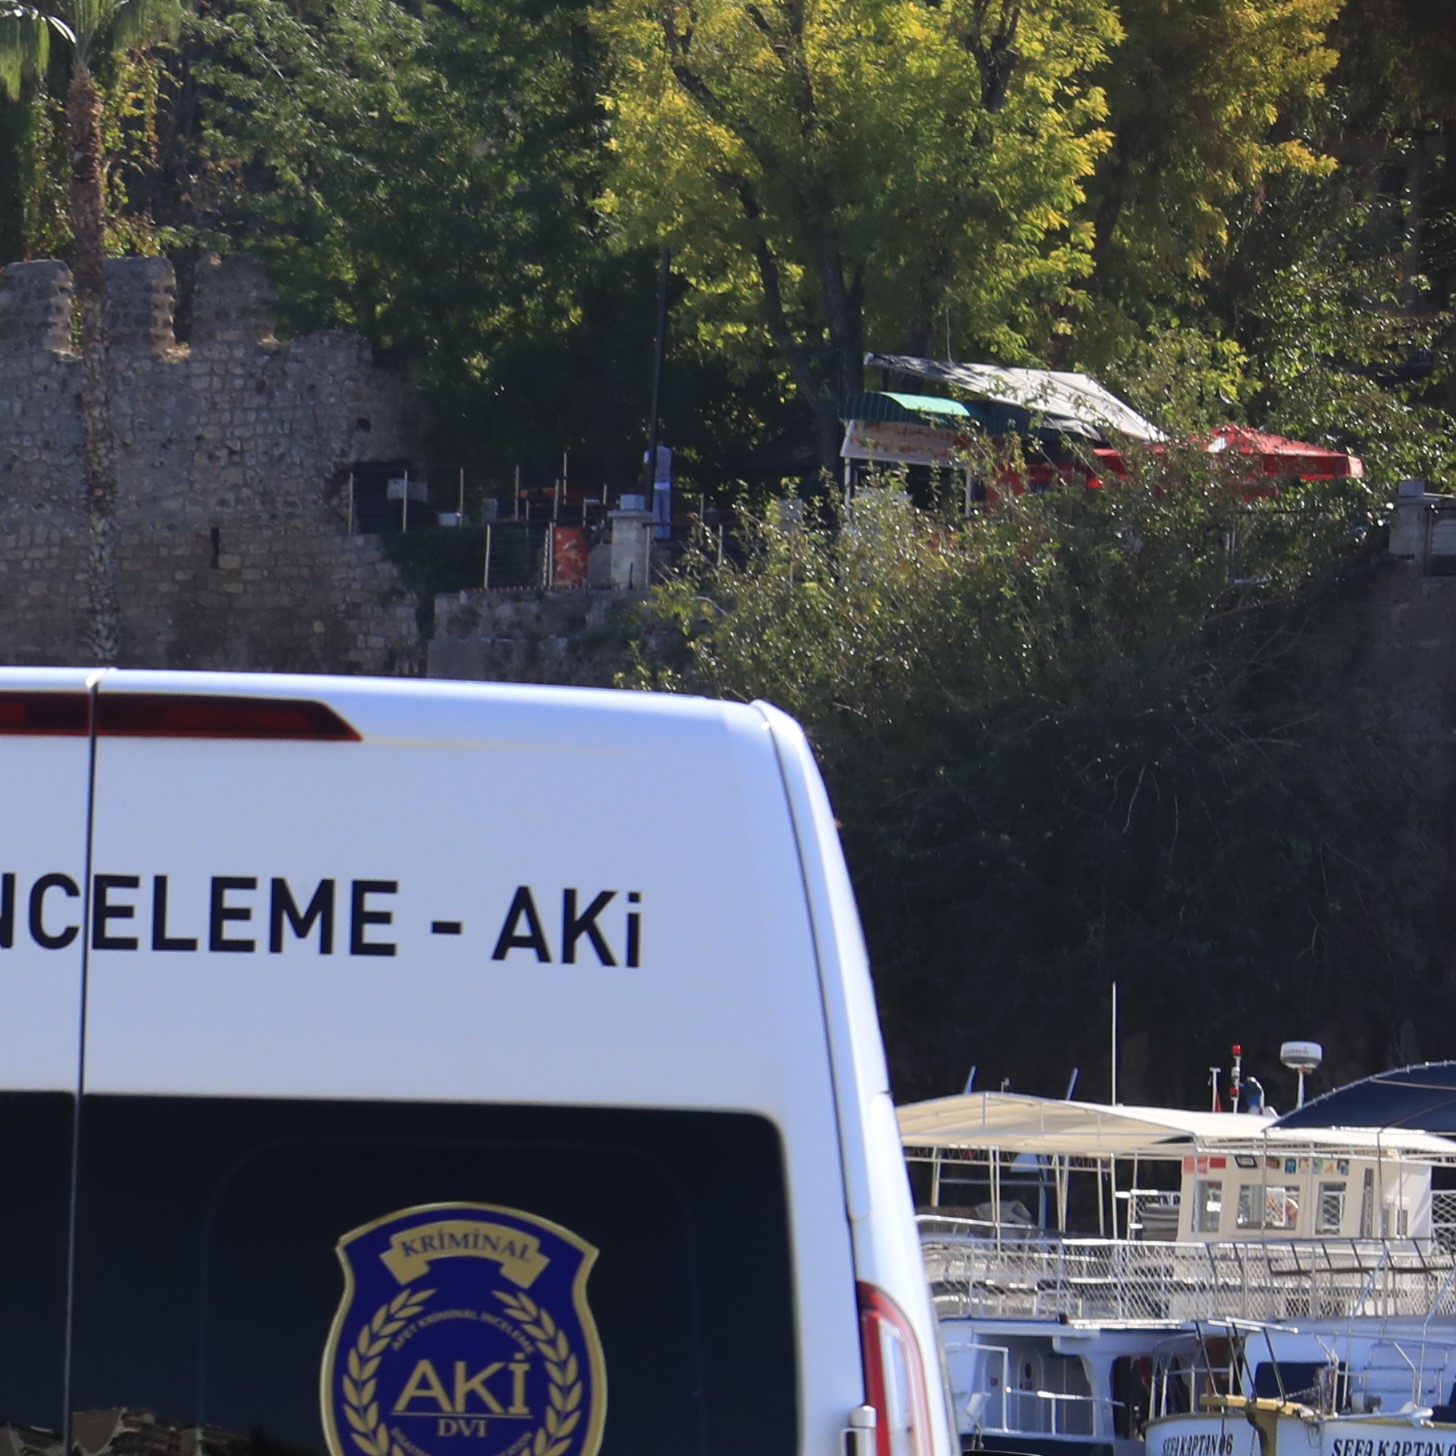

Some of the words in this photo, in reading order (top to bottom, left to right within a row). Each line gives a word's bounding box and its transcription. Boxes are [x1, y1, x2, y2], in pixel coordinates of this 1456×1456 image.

[400, 1228, 532, 1262] KRİMİNAL
[392, 1352, 531, 1414] AKİ
[438, 1419, 487, 1438] DVI
